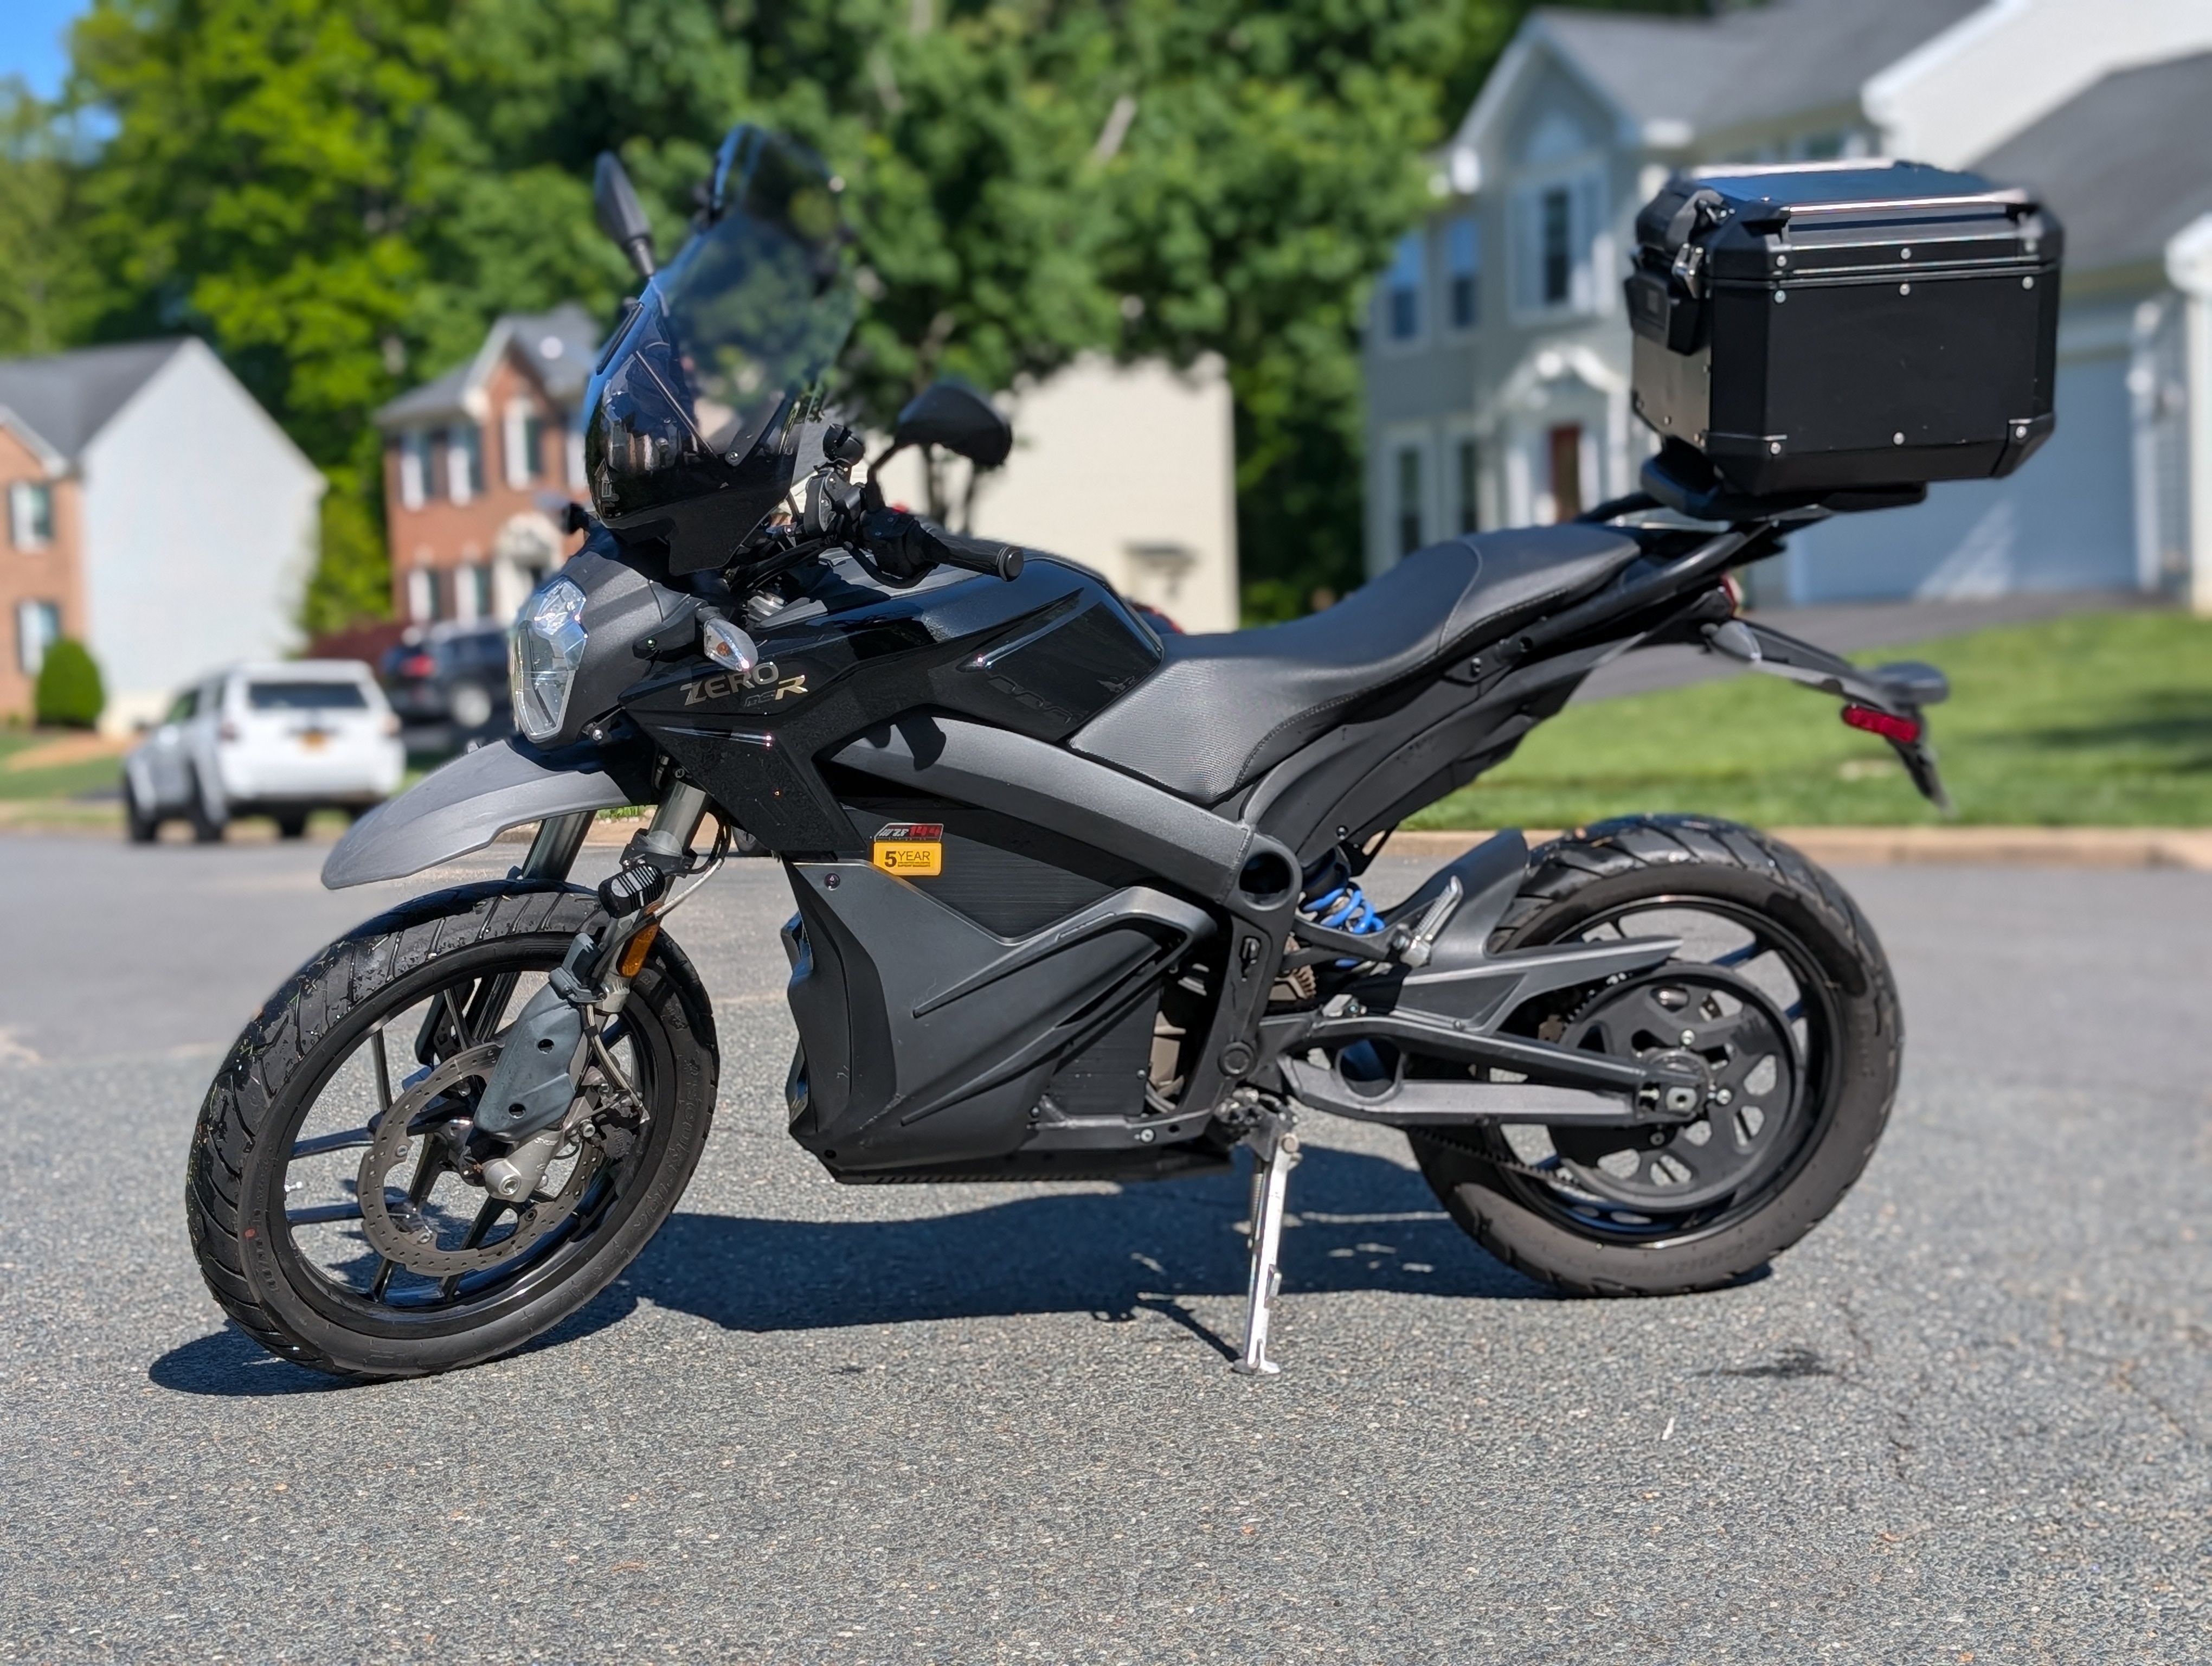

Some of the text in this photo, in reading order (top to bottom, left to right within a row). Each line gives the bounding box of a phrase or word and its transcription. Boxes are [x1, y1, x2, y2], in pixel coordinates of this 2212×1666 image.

[680, 662, 779, 706] ZERO
[884, 850, 930, 868] 5 YEAR
